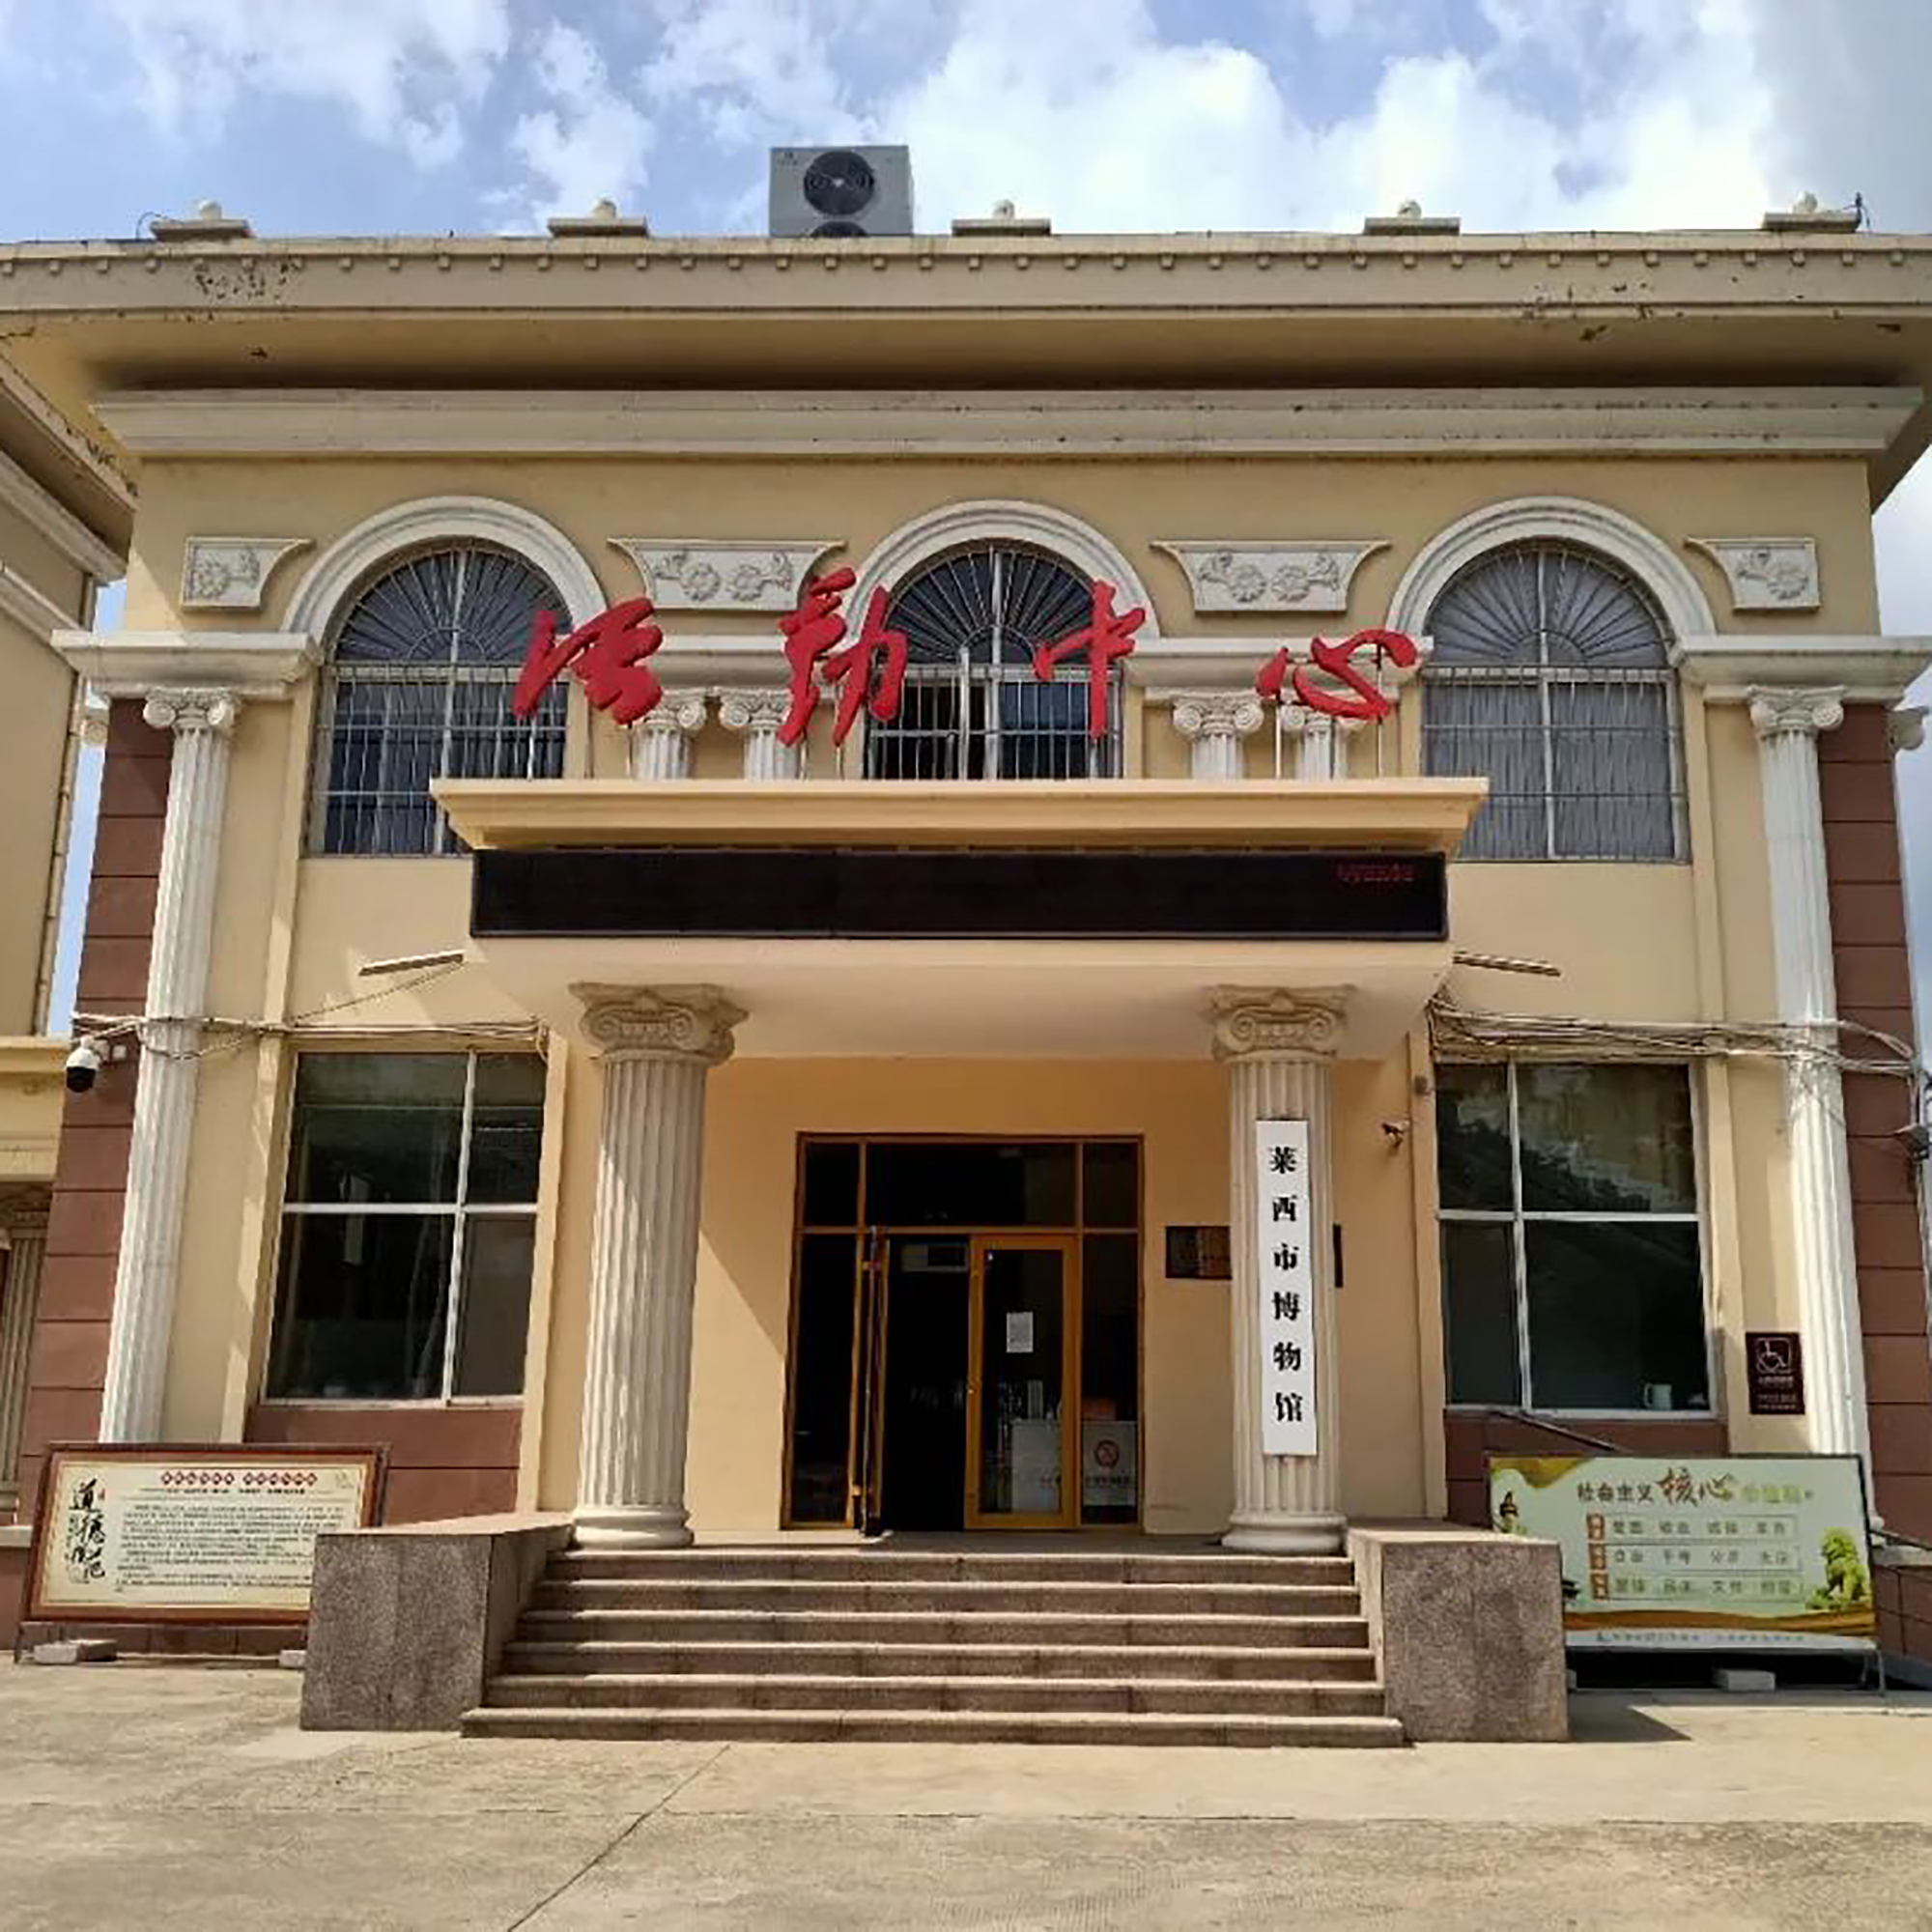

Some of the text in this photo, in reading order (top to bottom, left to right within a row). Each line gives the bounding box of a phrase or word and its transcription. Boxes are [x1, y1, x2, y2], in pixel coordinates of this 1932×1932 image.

[1269, 1146, 1303, 1423] 莱西市博物馆
